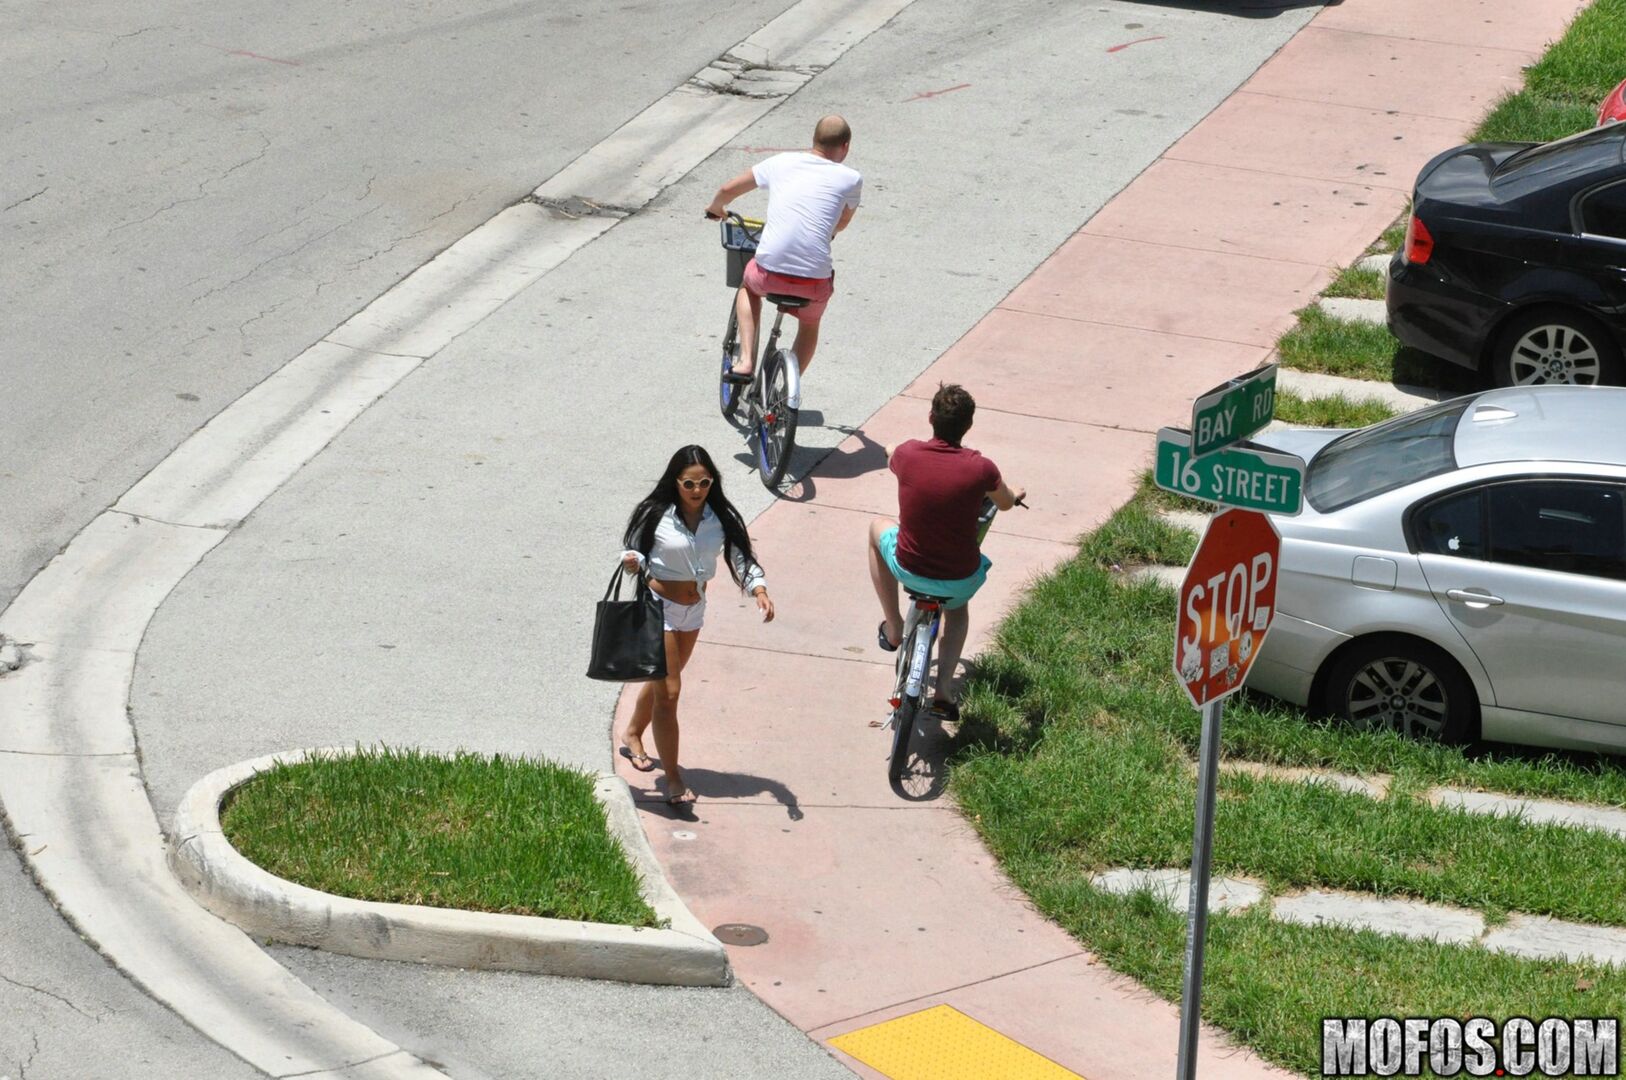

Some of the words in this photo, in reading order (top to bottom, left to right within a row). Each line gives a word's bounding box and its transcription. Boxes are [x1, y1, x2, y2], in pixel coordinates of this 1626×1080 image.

[1197, 405, 1238, 447] BAY
[1252, 387, 1272, 422] RD
[1171, 451, 1201, 493] 16
[1211, 463, 1291, 505] STREET
[1182, 552, 1272, 648] STOP
